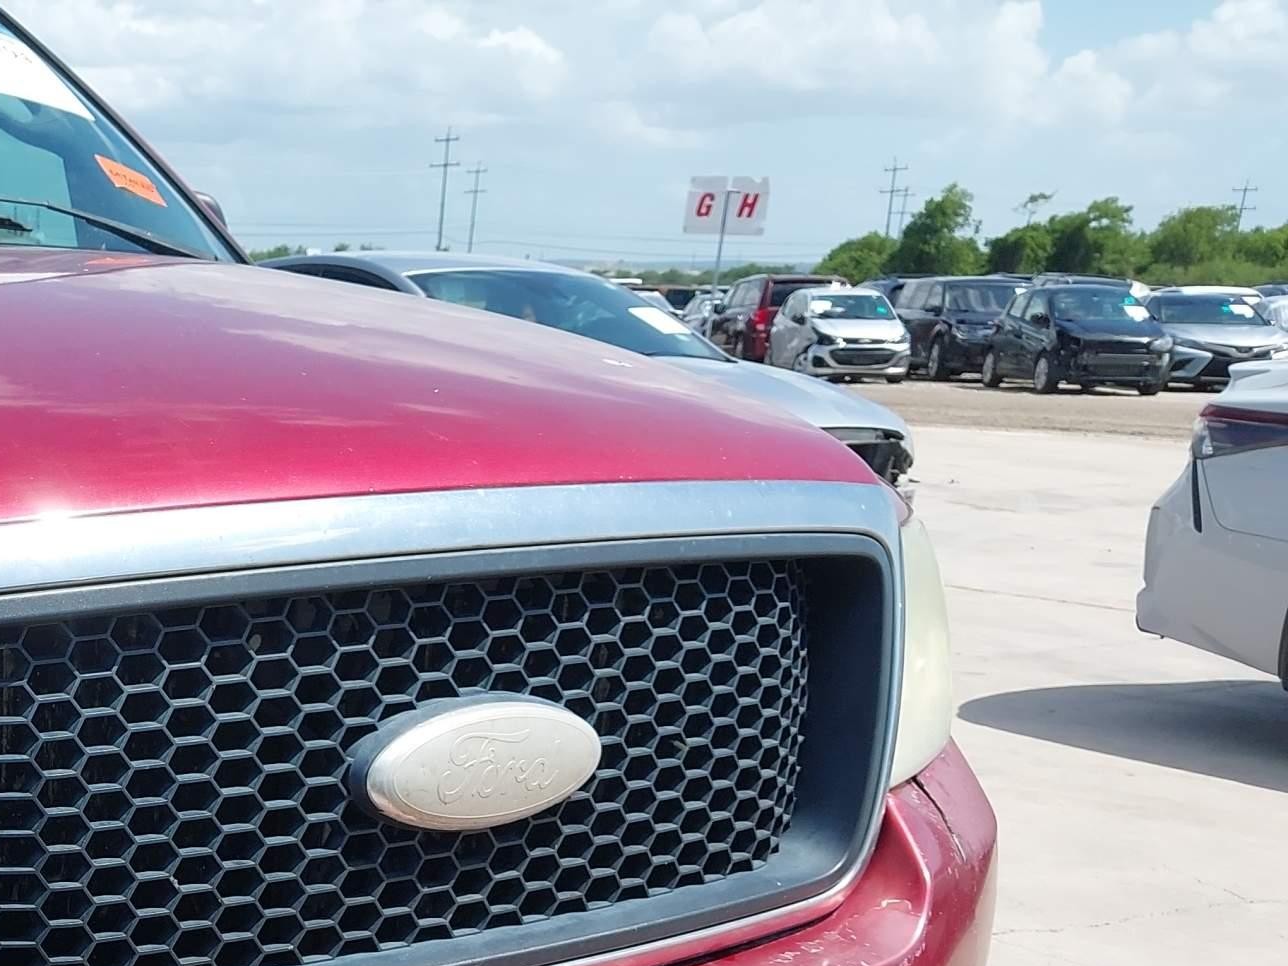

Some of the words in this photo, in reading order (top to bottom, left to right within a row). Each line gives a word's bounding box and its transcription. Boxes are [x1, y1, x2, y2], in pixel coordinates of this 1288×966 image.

[696, 192, 715, 217] G
[736, 192, 760, 218] H
[436, 727, 561, 805] Ford
